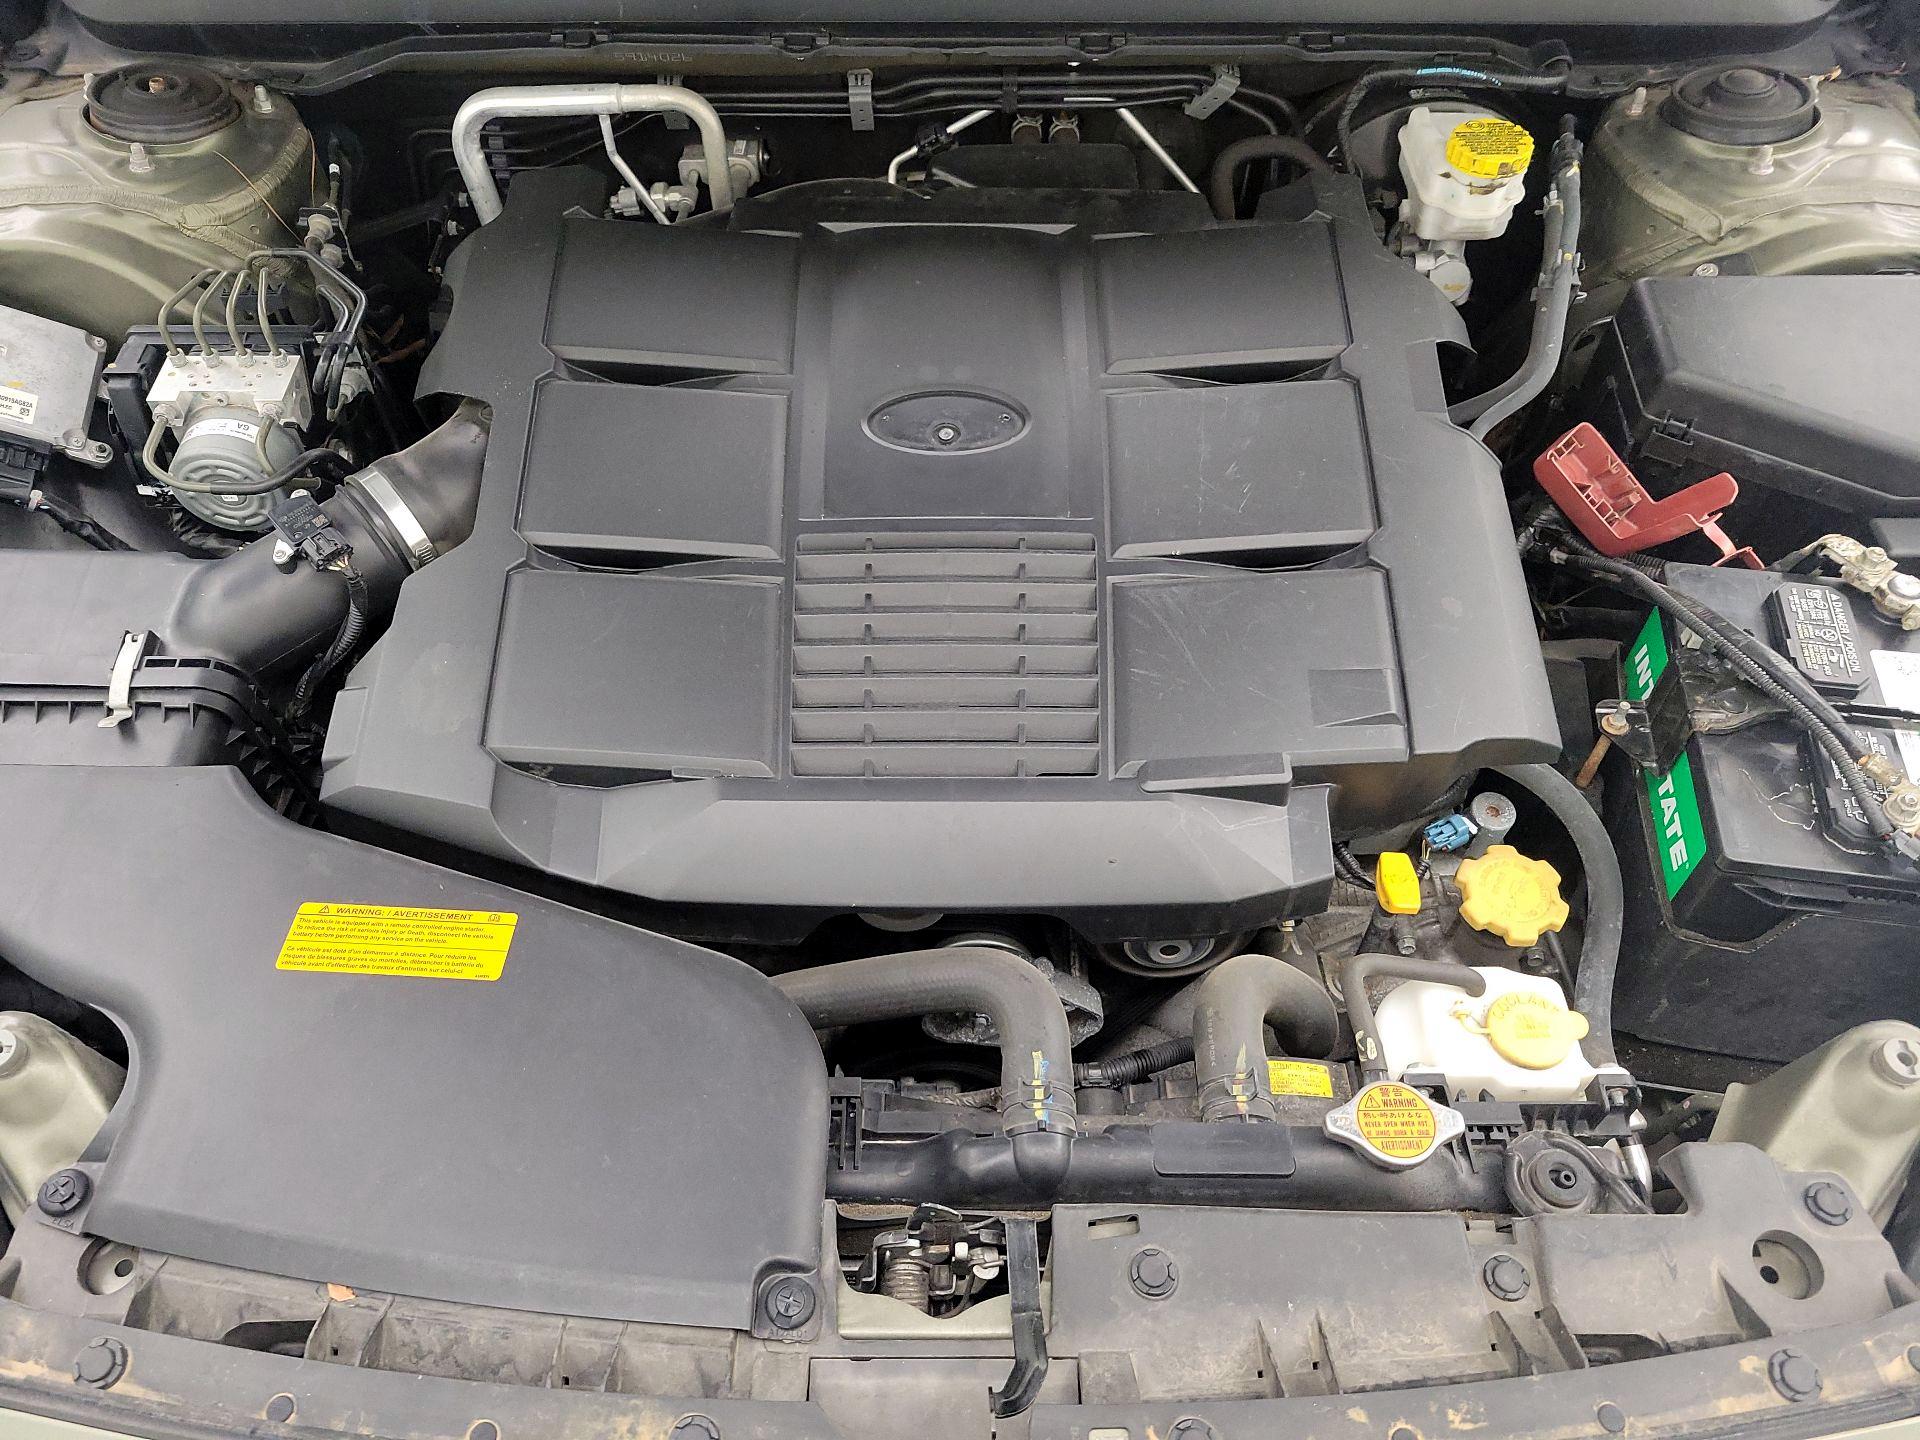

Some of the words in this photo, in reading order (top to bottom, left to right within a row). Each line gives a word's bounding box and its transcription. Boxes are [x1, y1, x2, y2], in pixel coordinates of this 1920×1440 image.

[1832, 602, 1850, 633] DANGER
[1844, 641, 1861, 672] POISON
[336, 907, 384, 916] WARNING:
[392, 910, 472, 919] AVERTISSEMENT
[1381, 1098, 1417, 1108] WARNING
